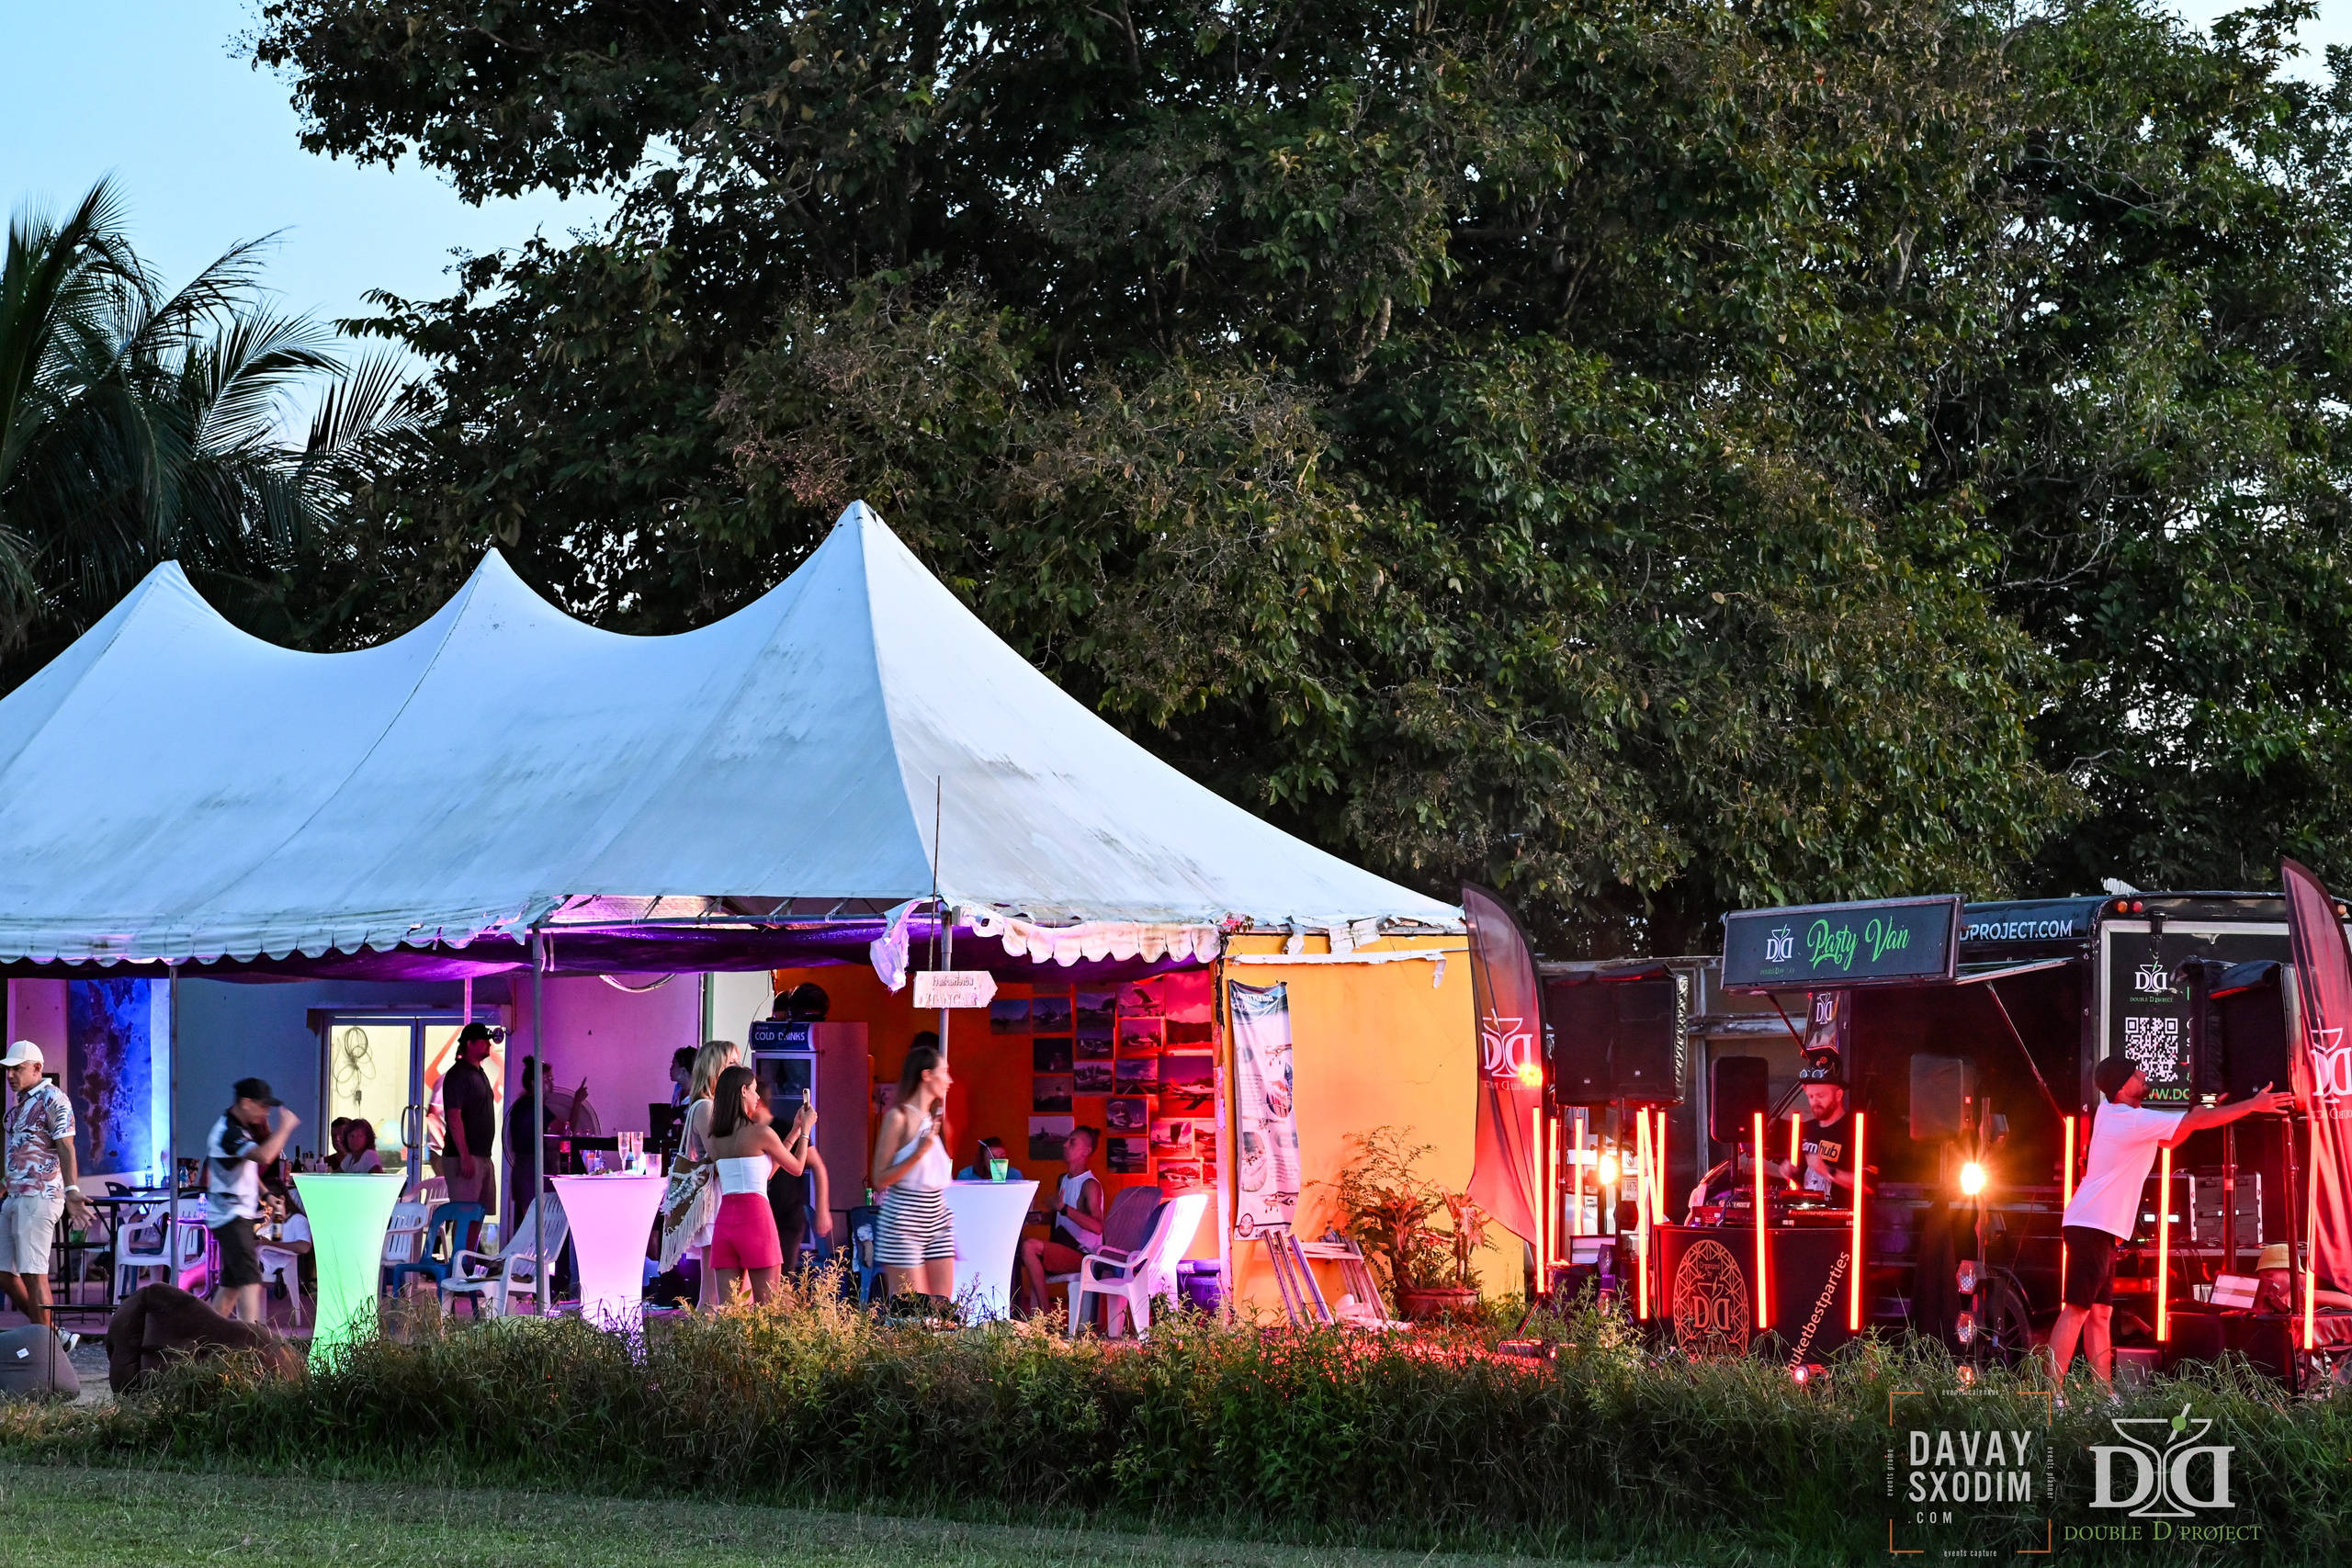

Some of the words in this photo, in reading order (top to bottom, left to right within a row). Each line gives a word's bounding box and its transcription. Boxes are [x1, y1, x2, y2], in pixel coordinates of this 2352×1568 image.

[1806, 919, 1858, 971] Party
[1864, 916, 1910, 963] Van
[754, 1032, 775, 1041] COLD
[1699, 1261, 1721, 1270] Organized
